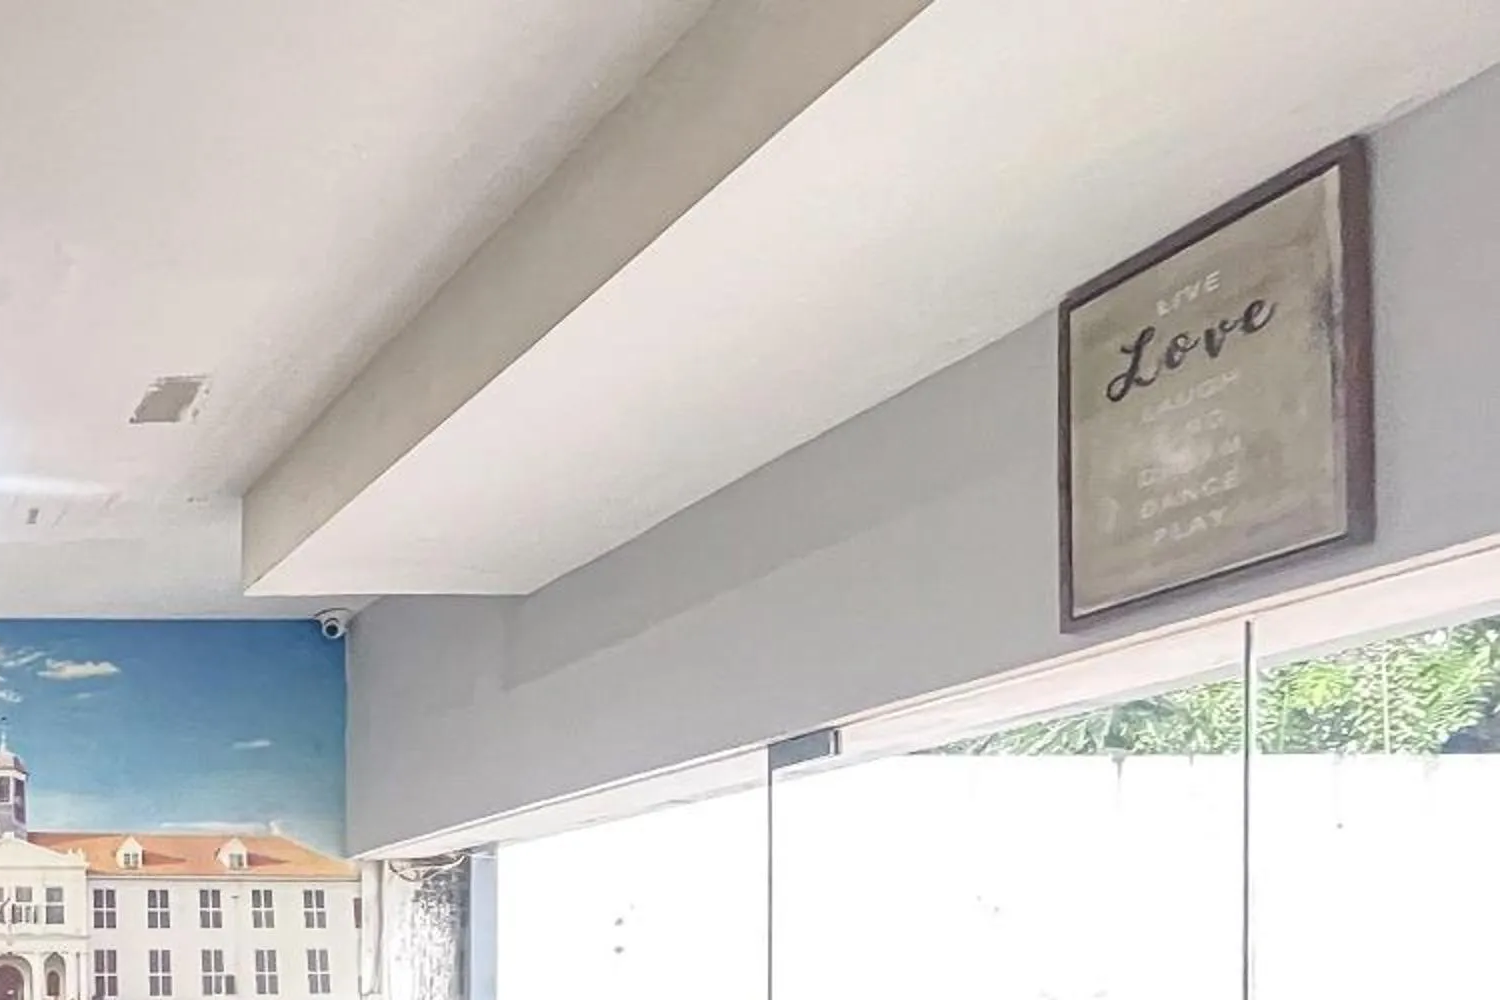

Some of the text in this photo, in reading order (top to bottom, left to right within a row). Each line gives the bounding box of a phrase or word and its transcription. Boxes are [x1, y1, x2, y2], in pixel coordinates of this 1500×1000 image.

[1156, 270, 1222, 318] LIVE
[1106, 299, 1275, 402] Love
[1154, 505, 1229, 541] PLAY
